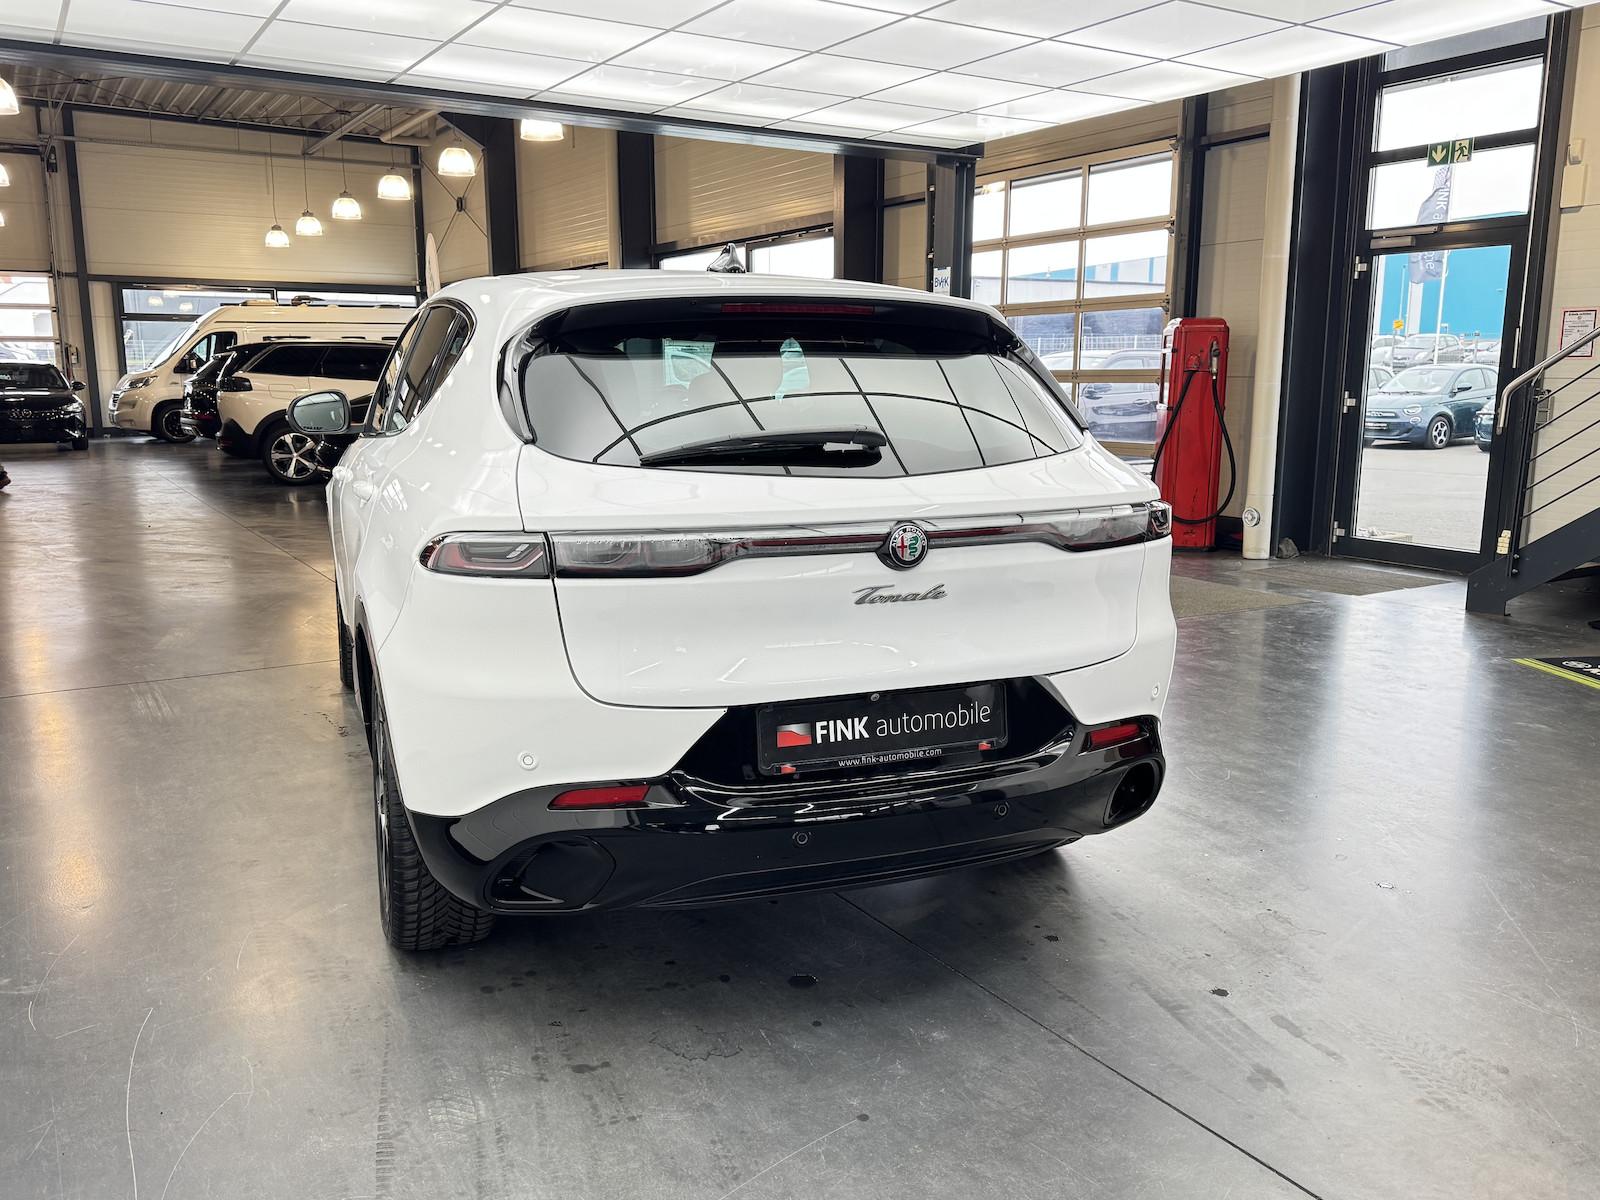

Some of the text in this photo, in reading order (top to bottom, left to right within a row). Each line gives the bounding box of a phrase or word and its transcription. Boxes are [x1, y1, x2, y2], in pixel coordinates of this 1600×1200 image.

[852, 584, 947, 605] Tonale
[815, 701, 991, 744] FINK automobile
[838, 748, 942, 767] www.fink-automobile.com
